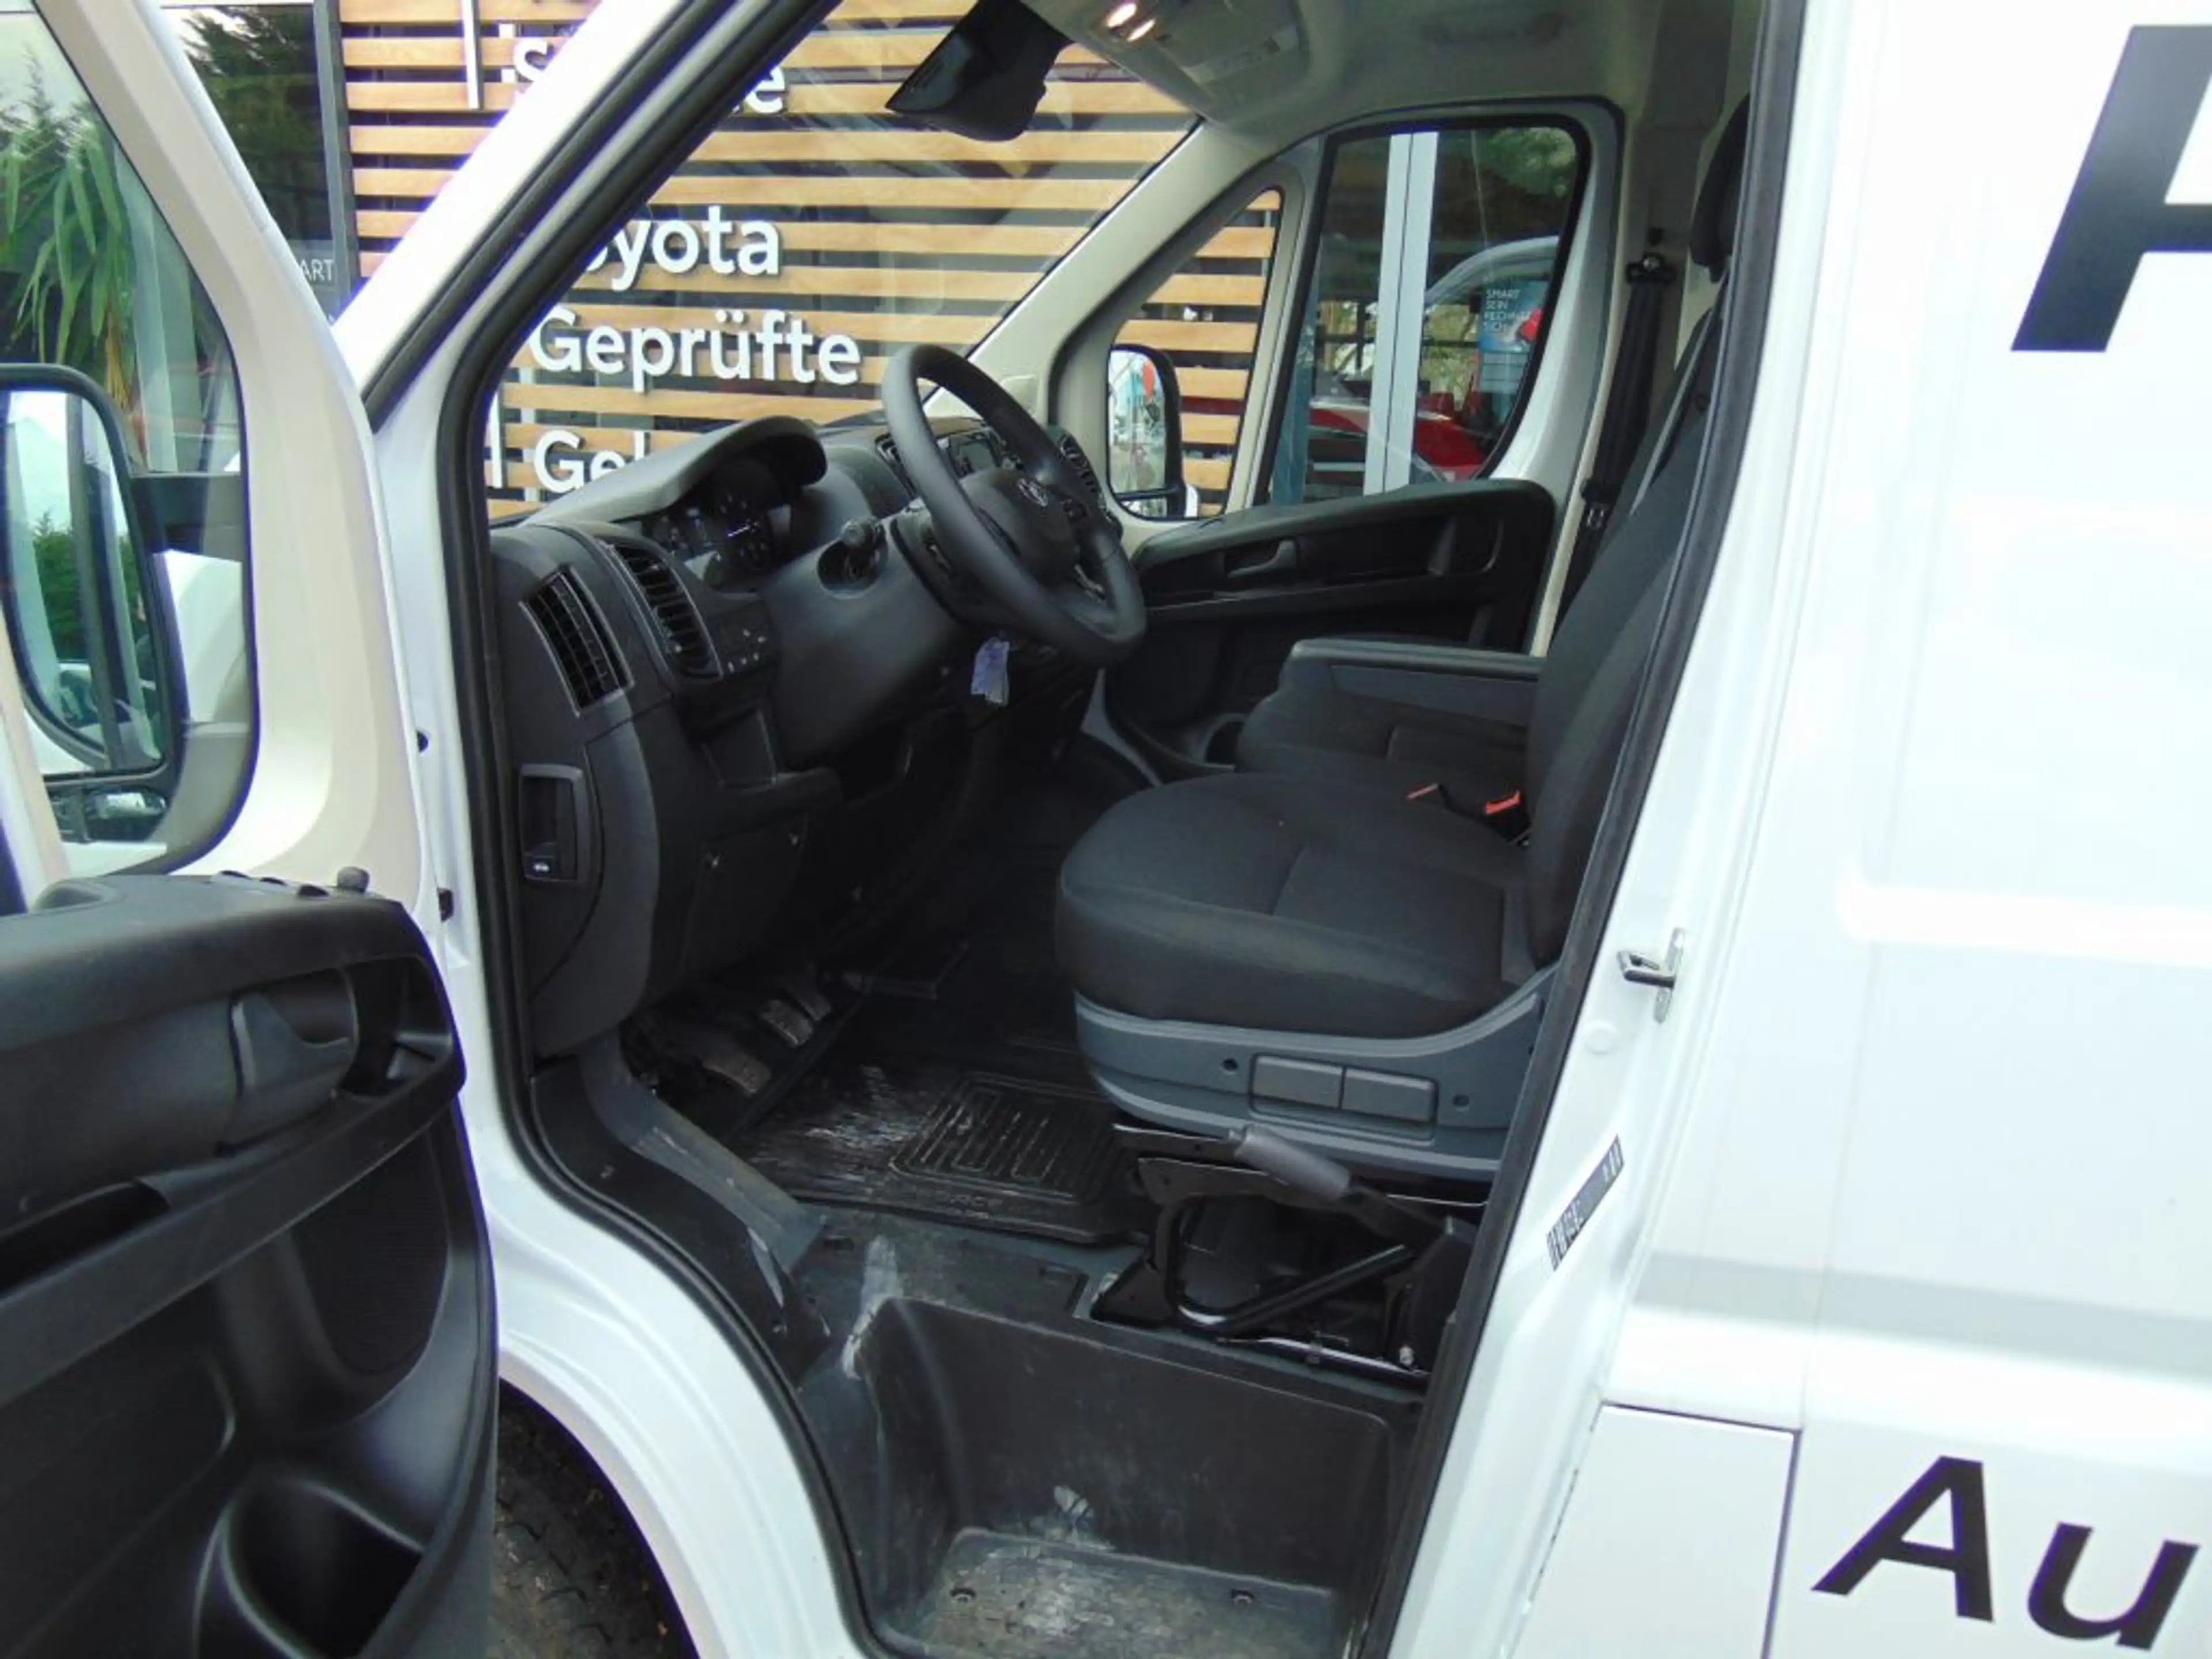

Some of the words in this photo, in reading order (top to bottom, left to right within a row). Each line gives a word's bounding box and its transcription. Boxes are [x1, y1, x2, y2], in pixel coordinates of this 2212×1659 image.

[586, 205, 780, 291] yota
[528, 304, 862, 393] Geprüfte
[1810, 1455, 2200, 1651] Au
